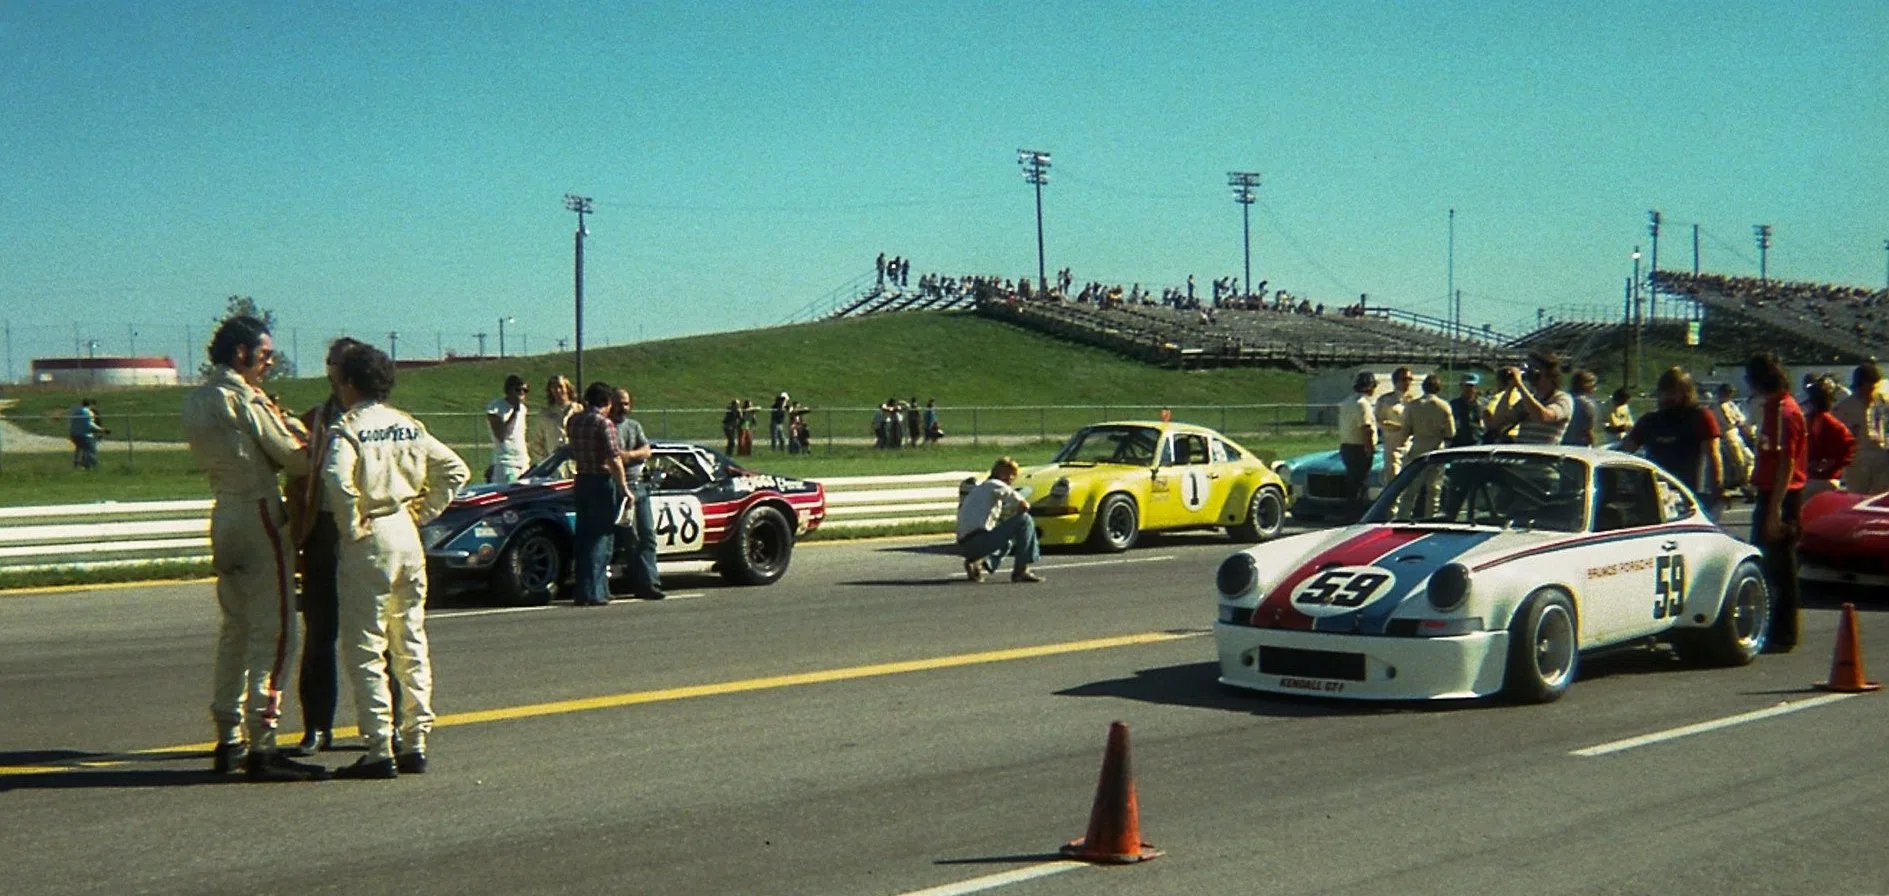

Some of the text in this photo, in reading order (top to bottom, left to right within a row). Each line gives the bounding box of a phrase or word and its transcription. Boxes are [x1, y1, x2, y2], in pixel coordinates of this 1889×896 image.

[1189, 472, 1200, 506] 1
[656, 502, 699, 546] 48
[1620, 558, 1653, 572] PORSCHE
[1295, 571, 1391, 608] 59
[1653, 555, 1685, 619] 59
[1280, 678, 1321, 690] KENDALL
